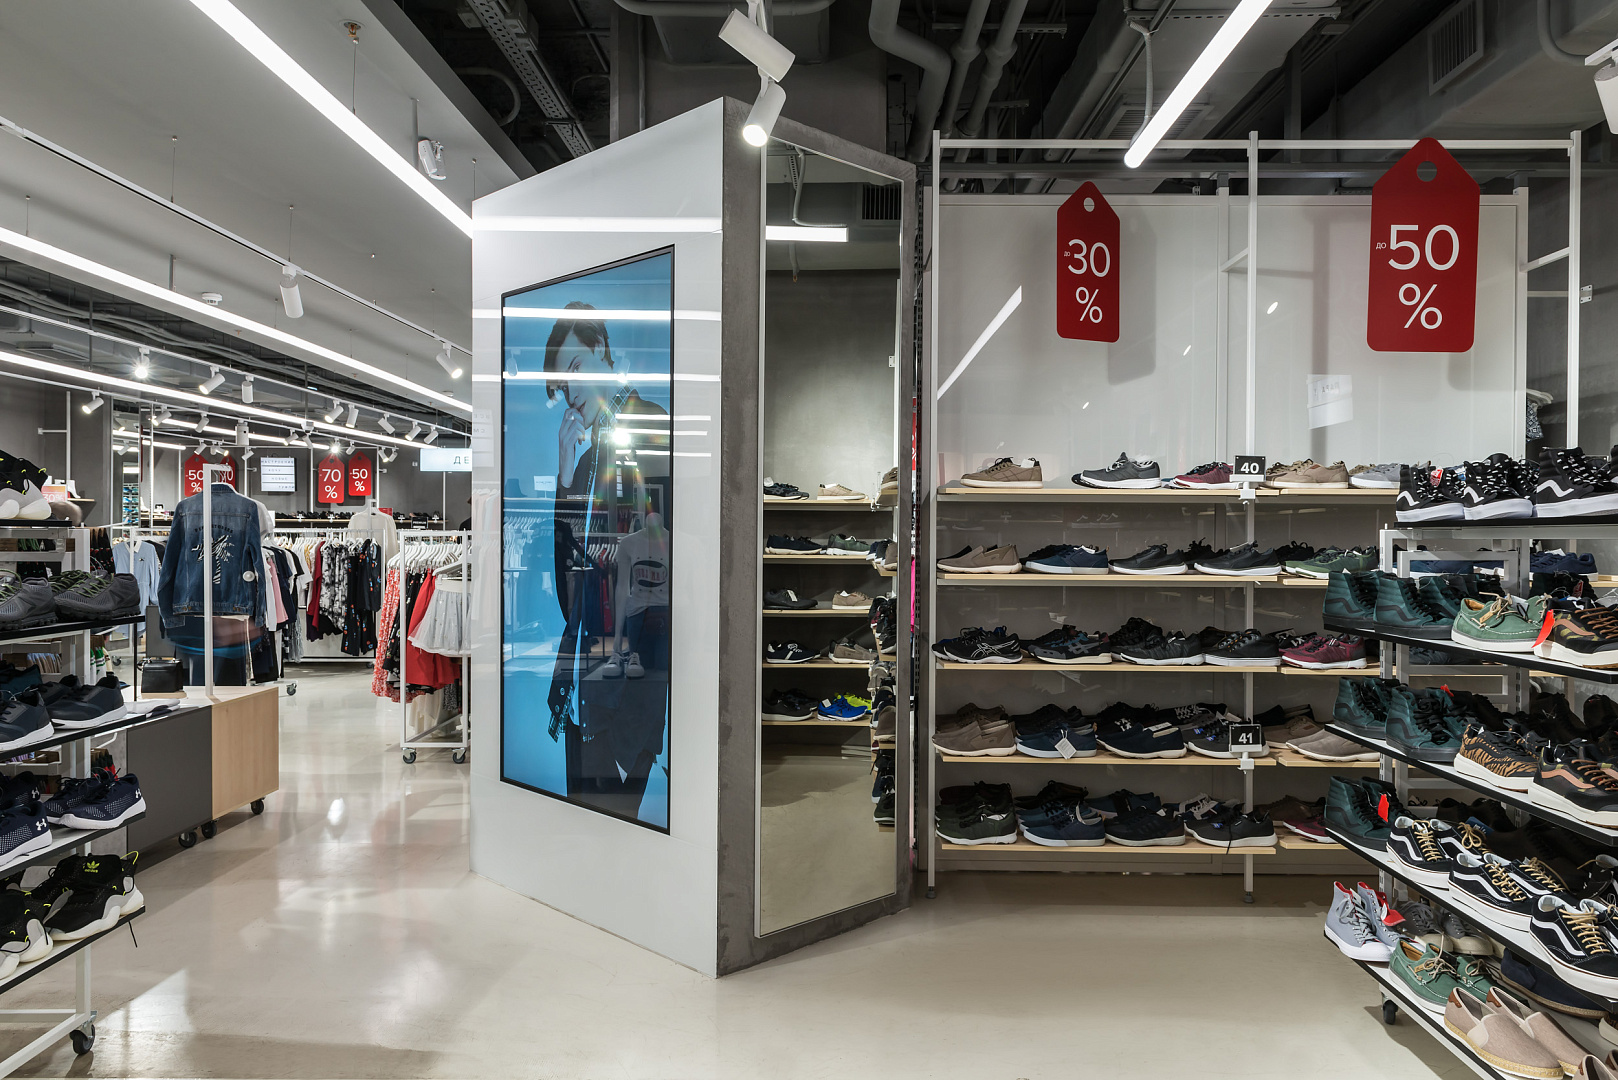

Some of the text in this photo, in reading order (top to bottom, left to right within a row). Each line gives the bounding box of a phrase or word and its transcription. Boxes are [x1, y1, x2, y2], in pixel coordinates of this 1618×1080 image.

[1376, 224, 1460, 271] до 50
[1067, 238, 1111, 278] 30
[1075, 286, 1103, 324] %
[1398, 283, 1443, 330] %
[1240, 462, 1260, 474] 40
[190, 481, 203, 493] %
[324, 485, 338, 499] %
[354, 480, 366, 492] %
[1238, 732, 1253, 744] 41
